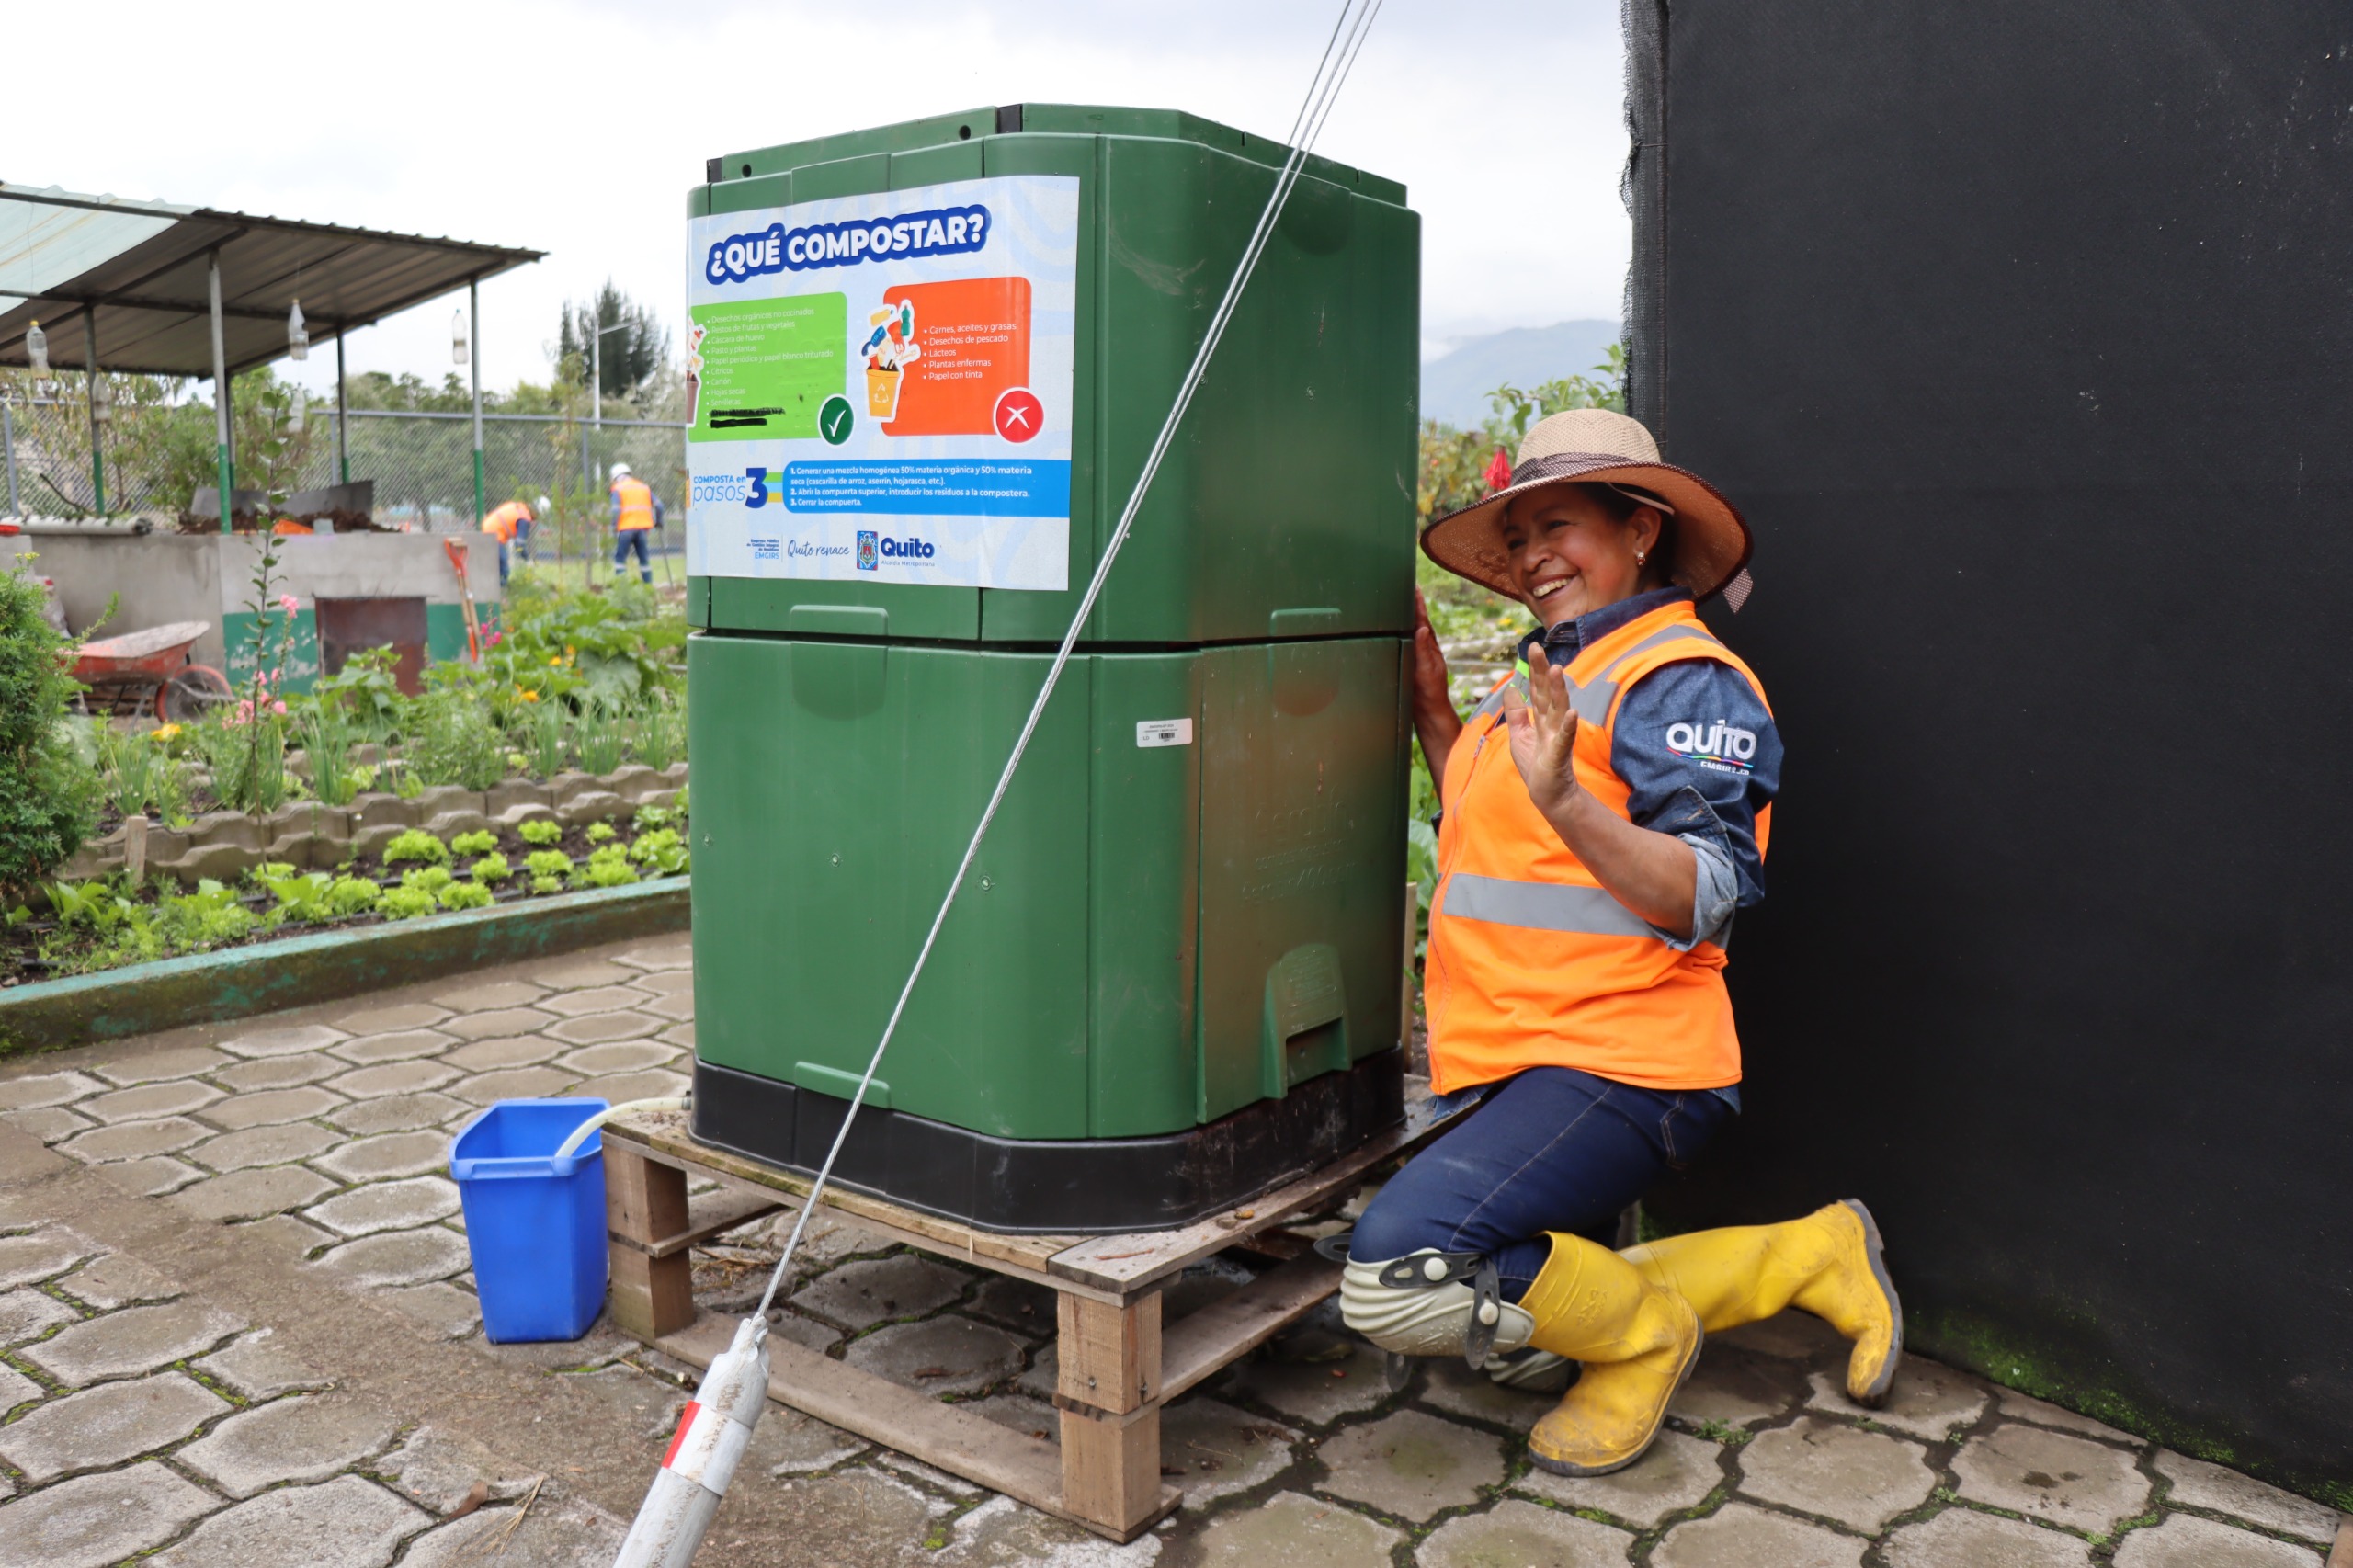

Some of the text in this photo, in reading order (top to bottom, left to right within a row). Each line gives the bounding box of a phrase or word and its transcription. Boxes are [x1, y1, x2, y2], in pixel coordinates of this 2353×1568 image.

[710, 212, 984, 277] ¿QUÉ COMPOSTAR?
[711, 314, 741, 324] Desechos
[742, 311, 772, 323] orgánicos
[783, 308, 814, 316] cocinados
[712, 324, 732, 333] Restos
[742, 323, 759, 331] frutas
[766, 321, 795, 331] vegetales
[930, 326, 956, 335] Carnes,
[958, 324, 983, 332] aceites
[991, 324, 1017, 333] grasas
[711, 335, 735, 344] Cáscara
[930, 337, 963, 346] Desechos
[976, 335, 1008, 345] pescado
[734, 345, 756, 354] plantas
[711, 357, 728, 365] Papel
[764, 353, 781, 363] papel
[804, 350, 834, 358] triturado
[929, 371, 949, 381] Papel
[711, 388, 728, 396] Hojas
[859, 466, 900, 476] homogénea
[901, 466, 915, 474] 50%
[915, 466, 942, 474] materia
[943, 466, 974, 476] orgánica
[982, 466, 996, 474] 50%
[998, 466, 1031, 474] materia
[694, 475, 734, 483] COMPOSTA
[745, 467, 767, 509] 3
[806, 477, 837, 485] (cascarilla
[868, 477, 892, 486] aserrín,
[893, 477, 927, 487] hojarasca,
[693, 484, 745, 506] pasos
[822, 489, 857, 497] compuerta
[858, 488, 887, 497] superior,
[889, 487, 921, 496] introducir
[923, 488, 933, 496] los
[935, 488, 963, 496] residuos
[980, 490, 1029, 499] compostera.
[787, 540, 850, 558] Quito renace
[881, 537, 936, 558] Quito
